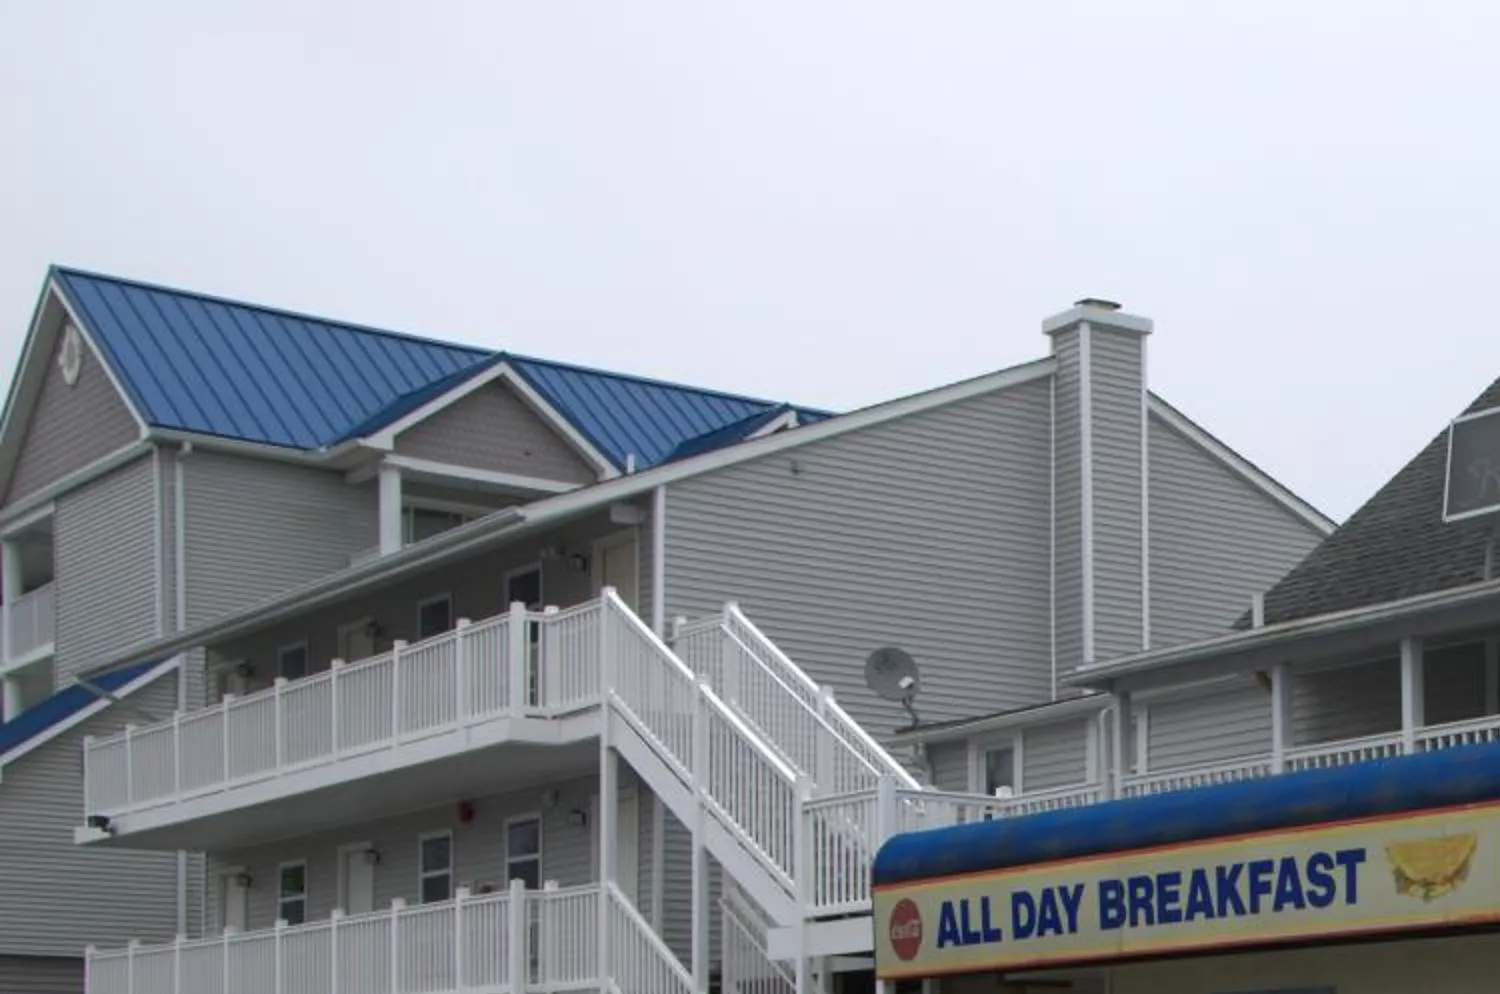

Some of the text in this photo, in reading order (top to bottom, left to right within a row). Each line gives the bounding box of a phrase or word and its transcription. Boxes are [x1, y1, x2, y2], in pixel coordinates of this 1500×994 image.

[936, 900, 1002, 949] ALL
[1012, 883, 1084, 938] DAY
[1099, 848, 1367, 931] BREAKFAST
